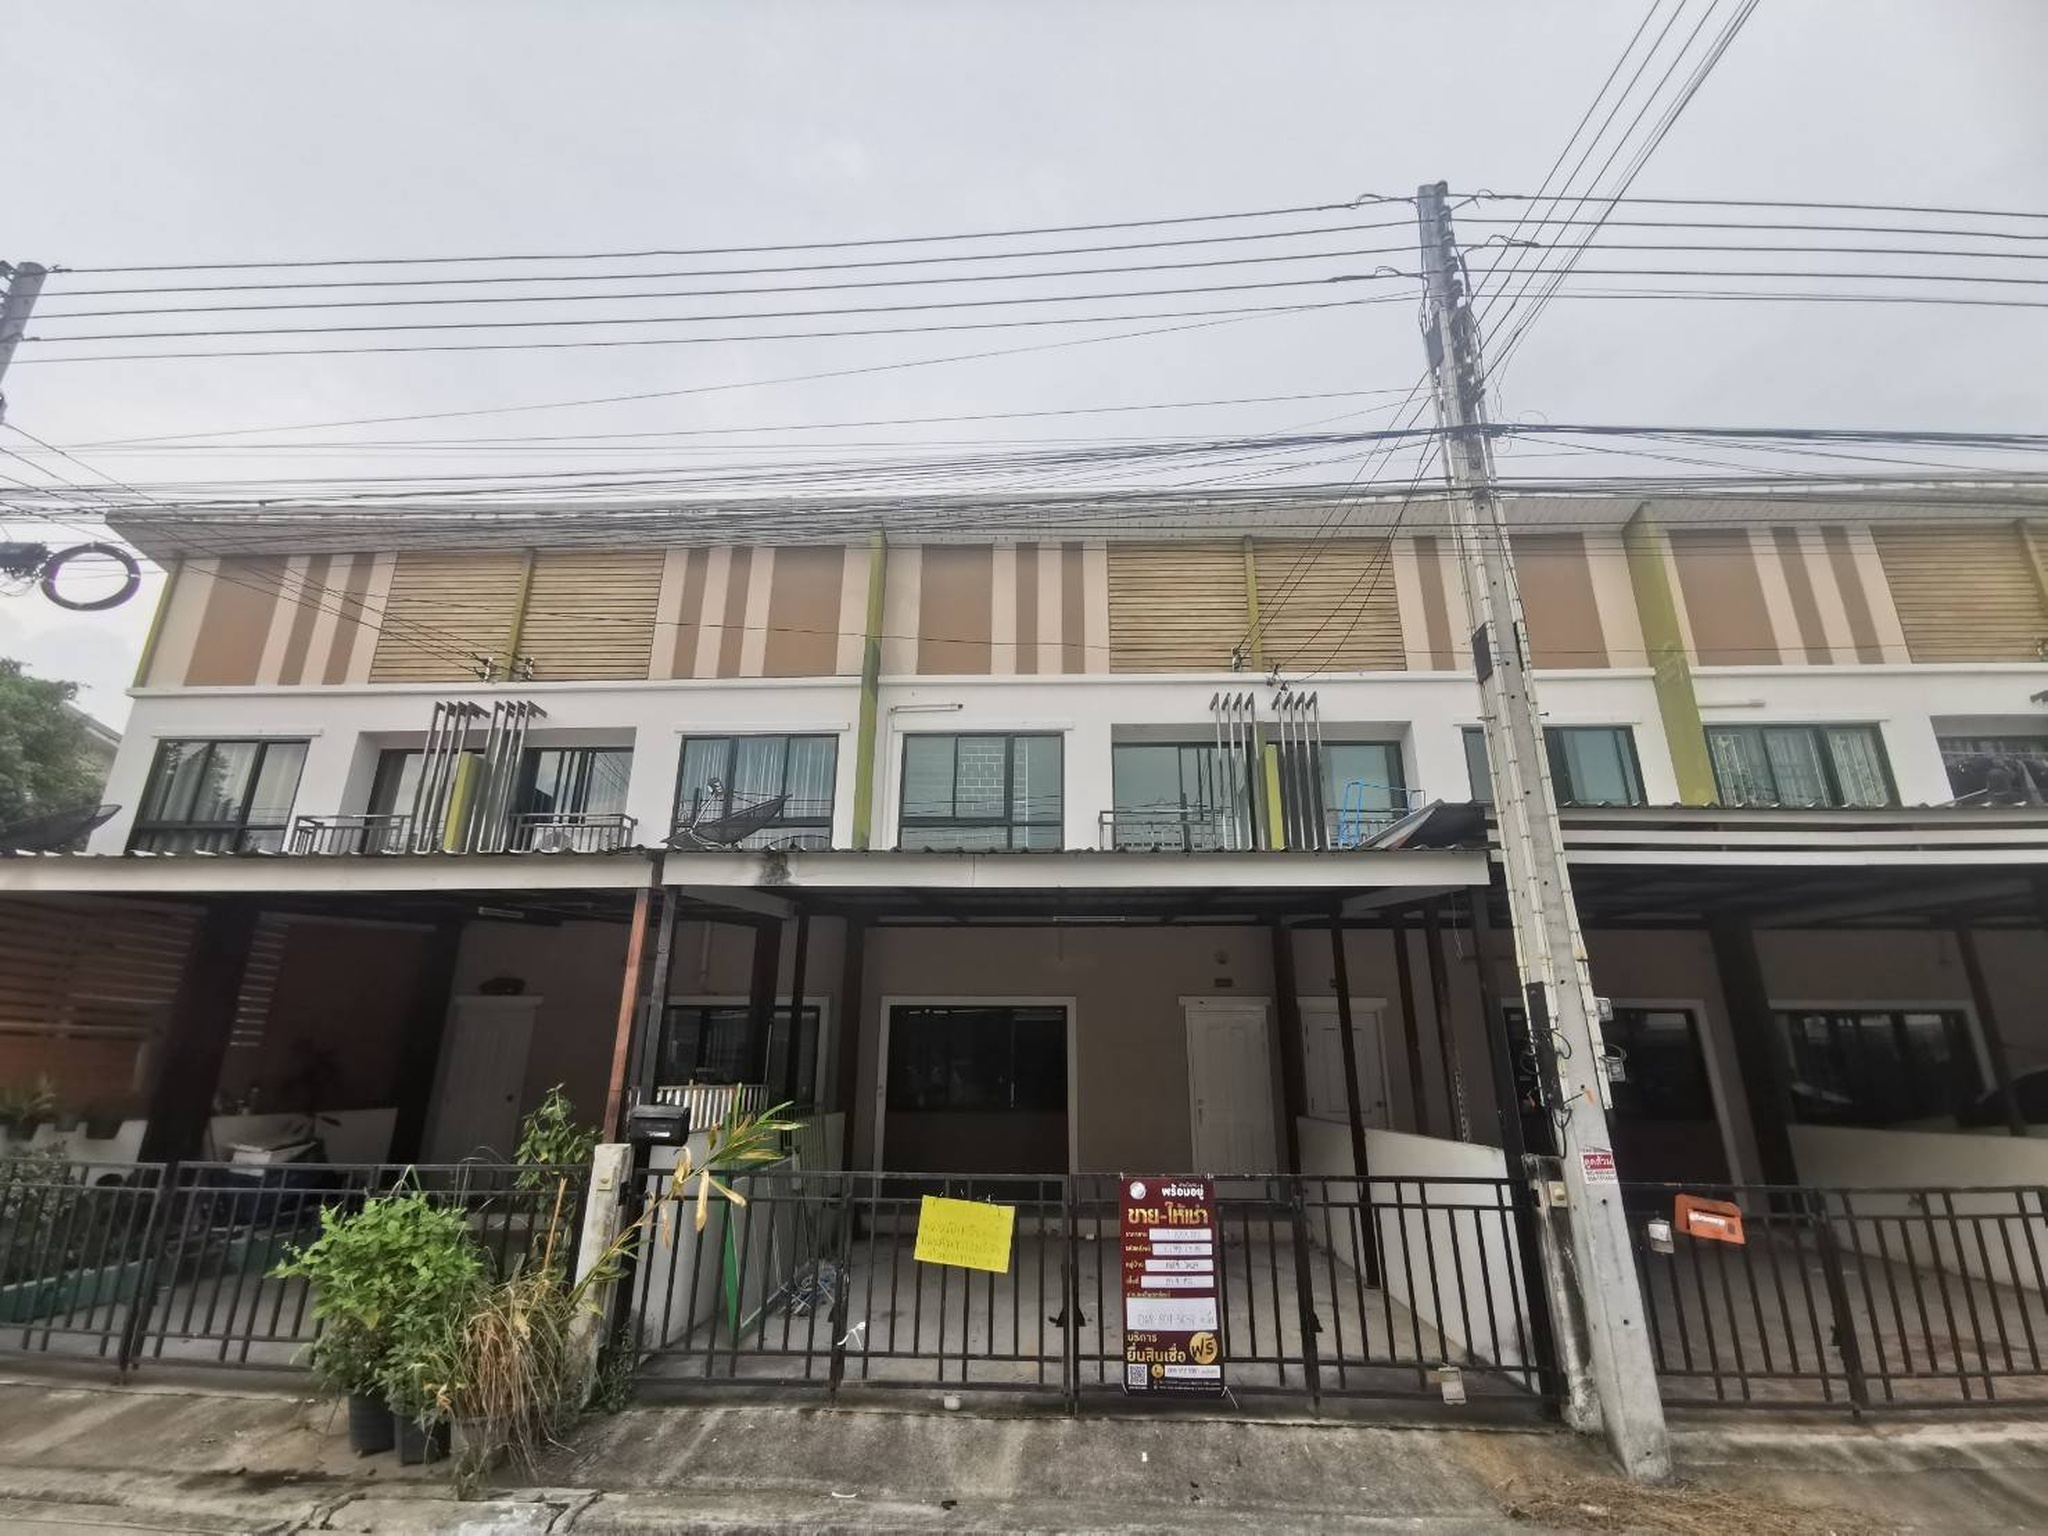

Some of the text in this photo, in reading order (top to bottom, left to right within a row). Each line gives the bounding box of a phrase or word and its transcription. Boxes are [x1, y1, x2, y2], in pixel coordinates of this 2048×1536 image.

[1127, 1201, 1209, 1225] ขาย-ให้เช่า
[1127, 1331, 1158, 1343] บริการ
[1191, 1333, 1214, 1358] ฟรี
[1127, 1342, 1187, 1363] ยื่นสินเชื่อ
